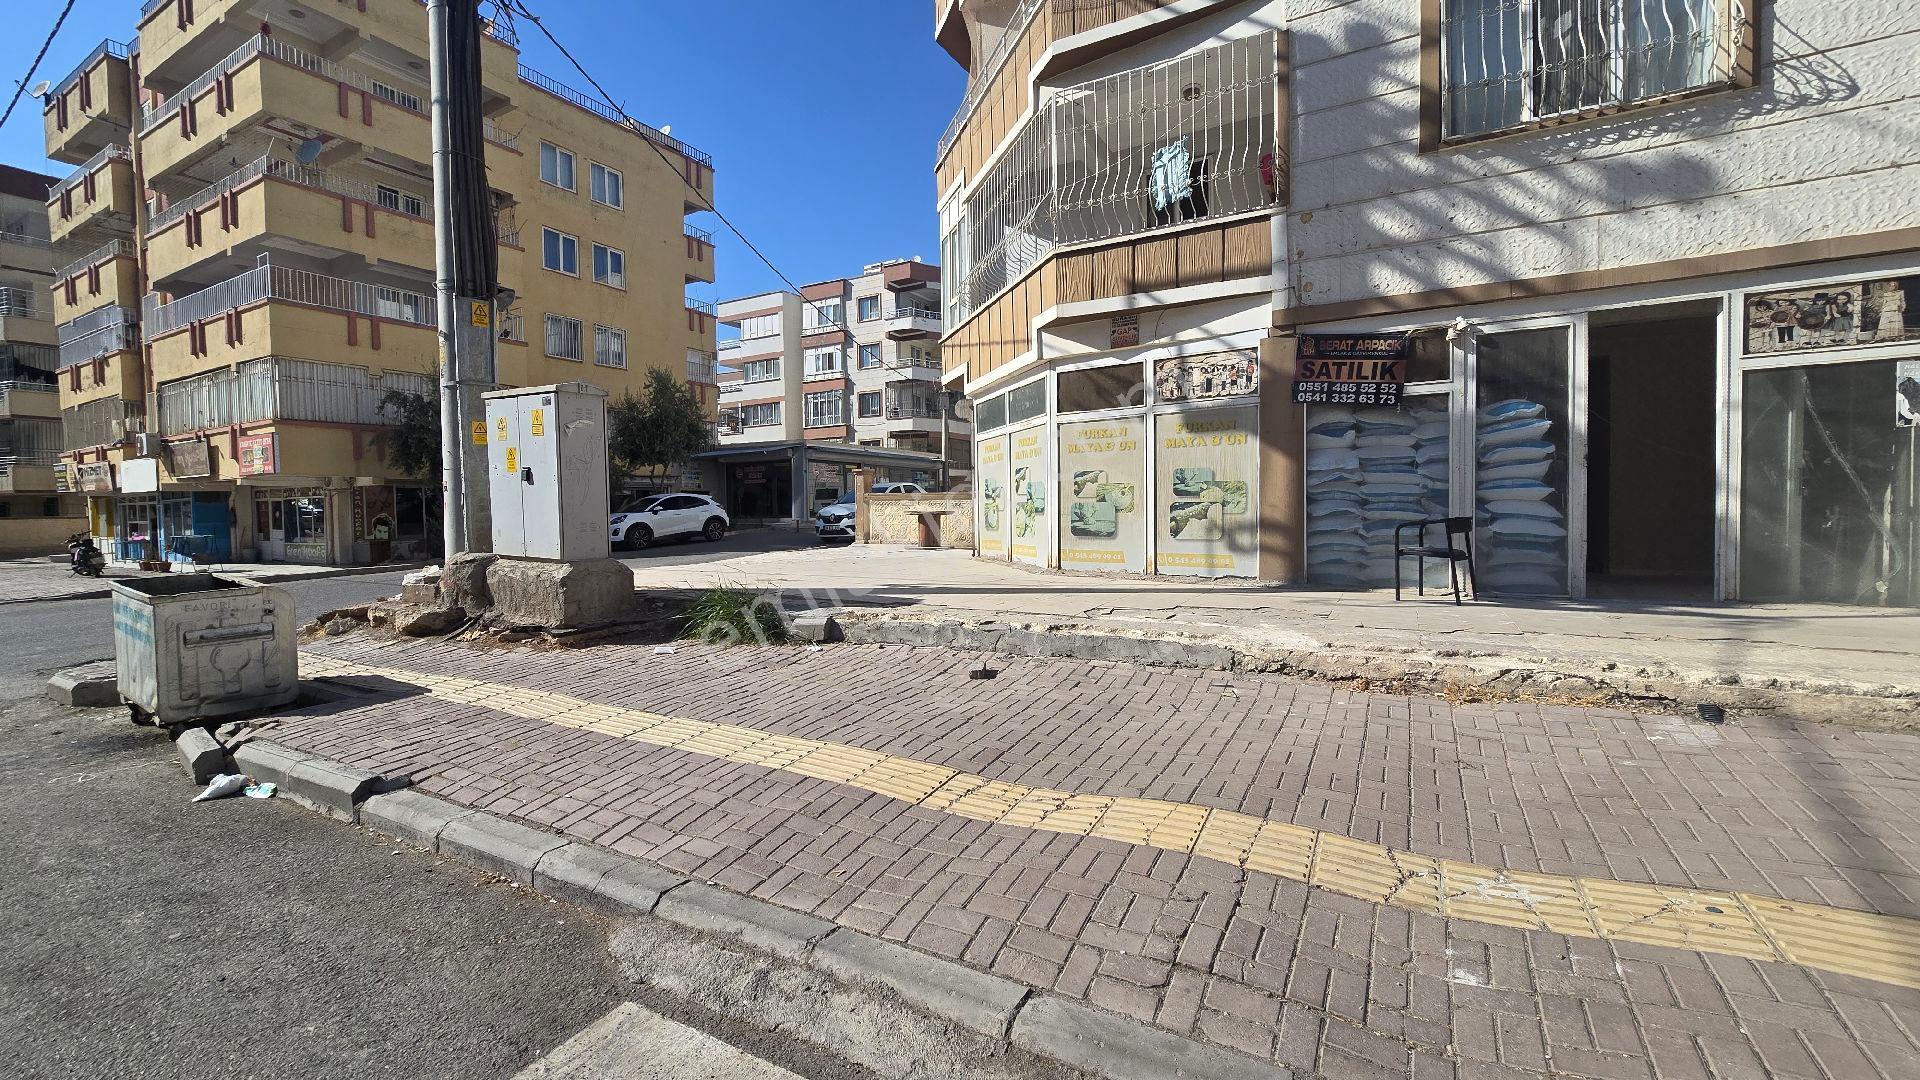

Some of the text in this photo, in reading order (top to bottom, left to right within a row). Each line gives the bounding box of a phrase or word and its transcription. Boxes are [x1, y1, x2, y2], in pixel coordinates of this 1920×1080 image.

[1301, 361, 1399, 380] SATILIK
[1299, 382, 1396, 393] 0551 485 52 52
[1298, 393, 1395, 404] 0541 332 63 73
[1175, 420, 1236, 434] FURKAN
[1119, 440, 1136, 451] UN
[1164, 436, 1207, 448] MAYA
[1225, 433, 1248, 445] UN
